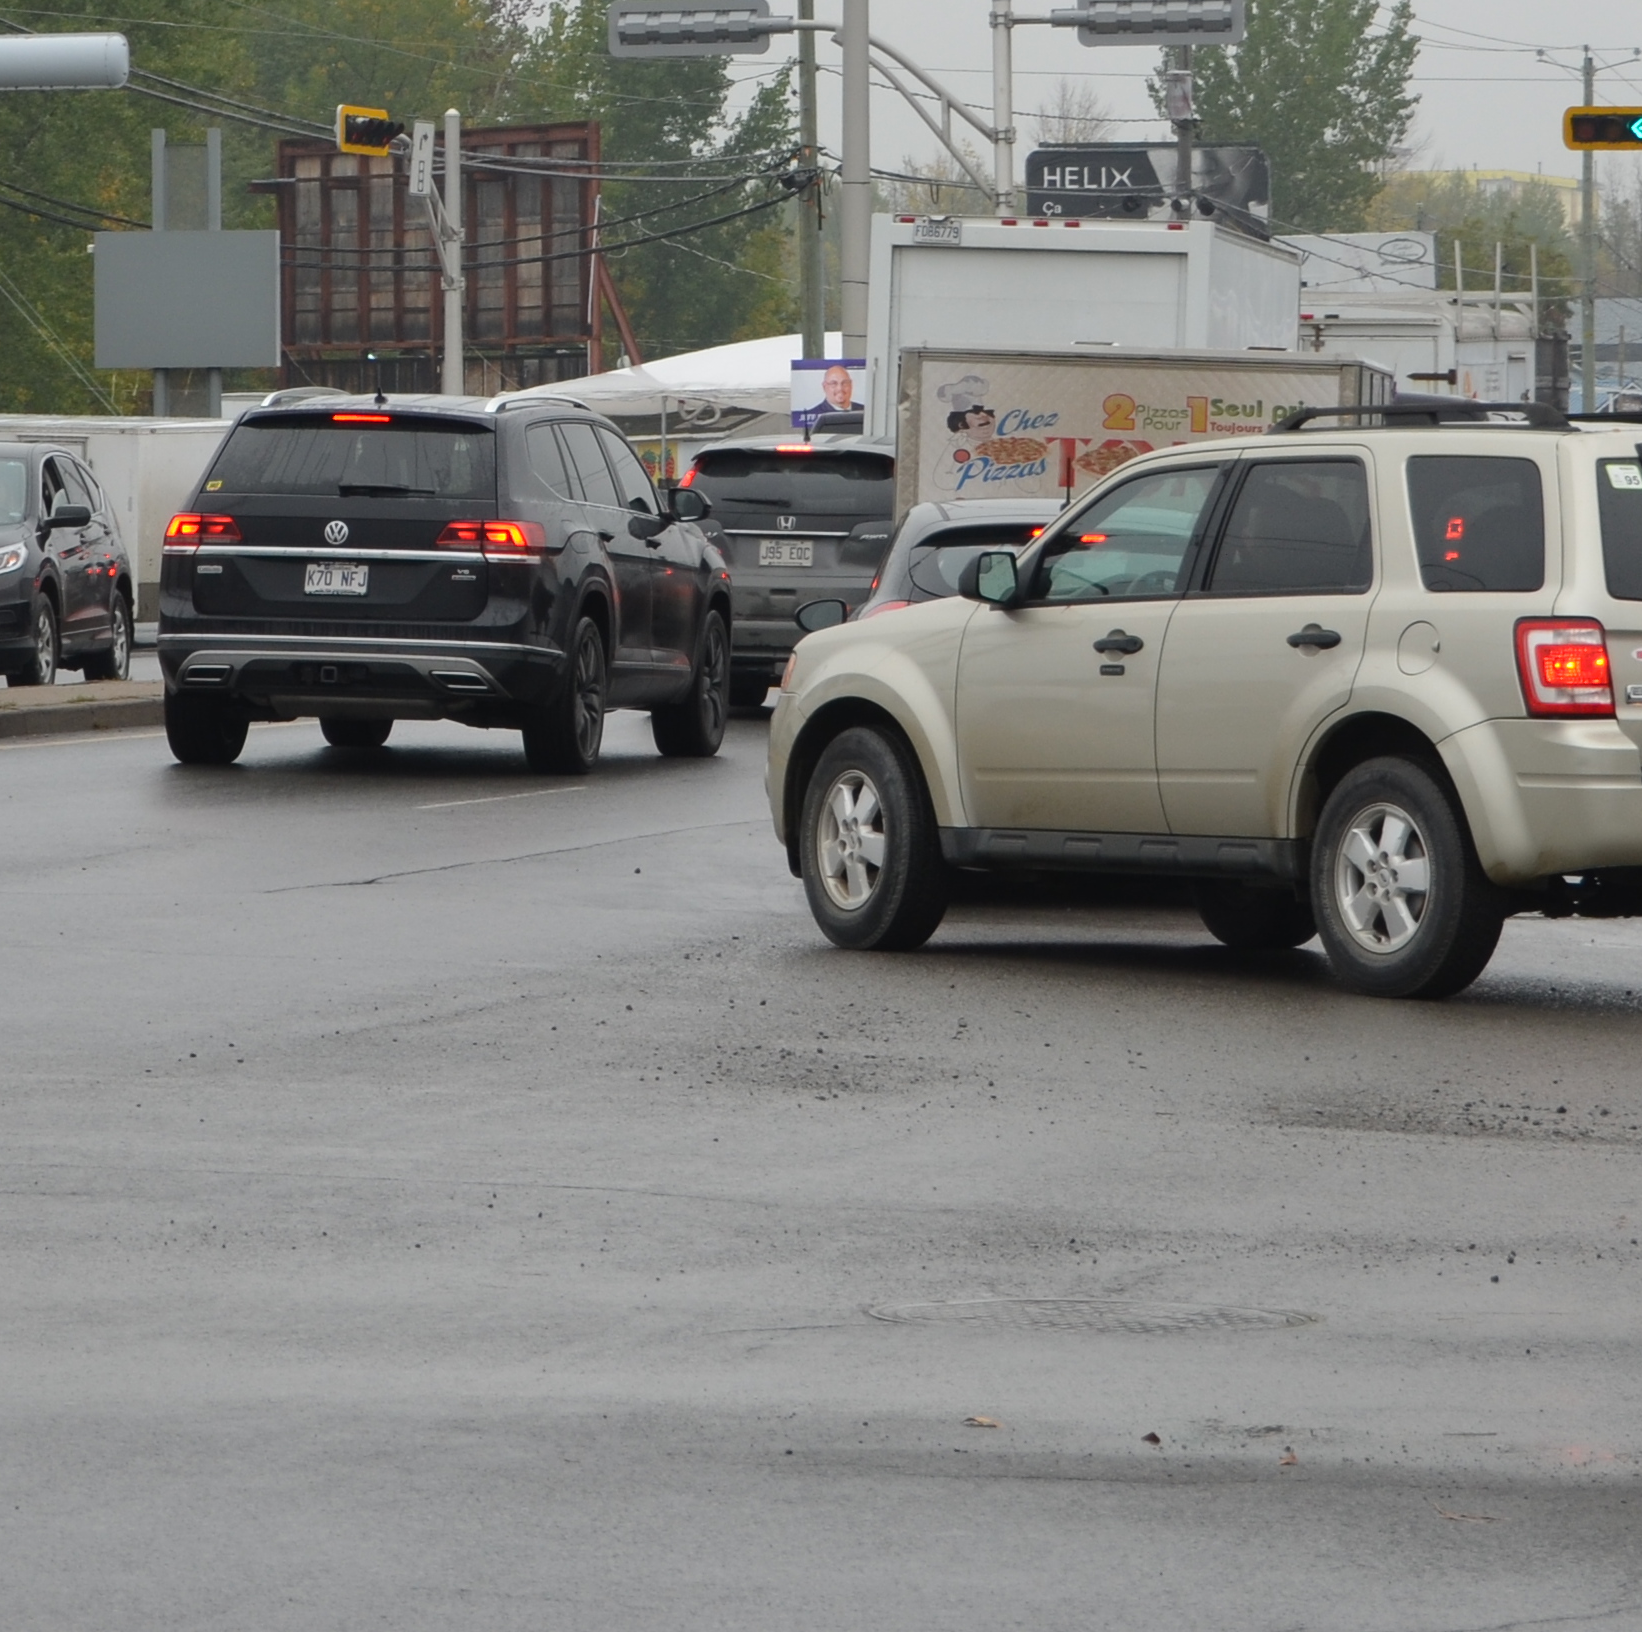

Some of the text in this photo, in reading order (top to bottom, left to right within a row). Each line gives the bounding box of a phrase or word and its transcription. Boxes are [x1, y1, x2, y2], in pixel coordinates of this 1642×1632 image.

[1043, 166, 1133, 189] HELIX
[1042, 201, 1062, 216] Ça
[996, 408, 1059, 437] Chez
[1102, 393, 1136, 430] 2
[1186, 396, 1208, 434] 1
[1210, 398, 1263, 418] Seul
[1142, 417, 1263, 435] Pour Toujours
[956, 455, 1048, 491] Pizzas
[307, 570, 368, 587] K70 NFJ
